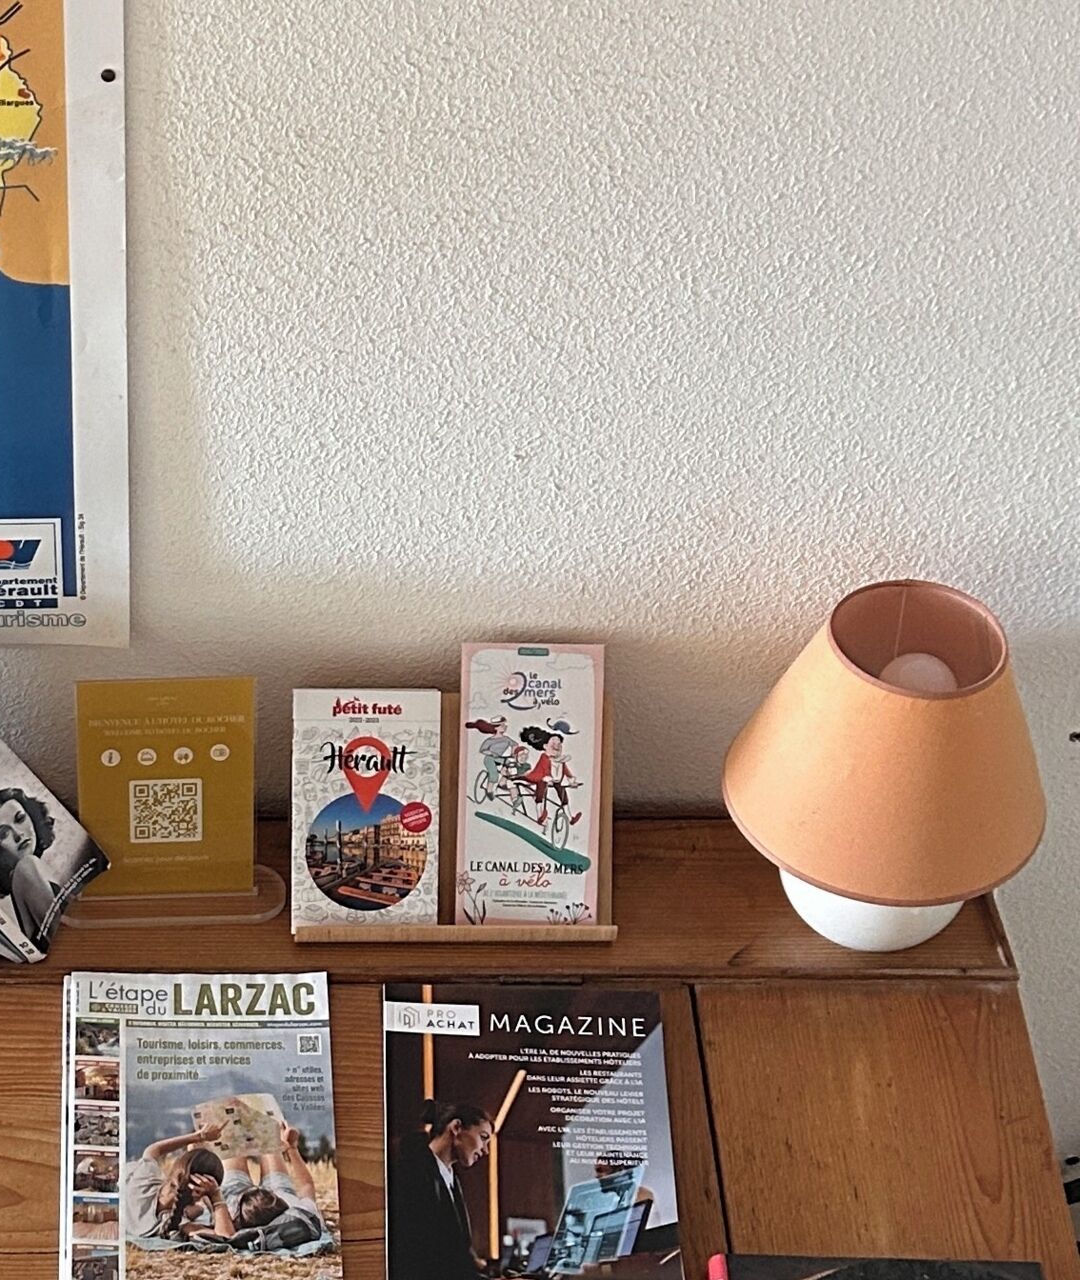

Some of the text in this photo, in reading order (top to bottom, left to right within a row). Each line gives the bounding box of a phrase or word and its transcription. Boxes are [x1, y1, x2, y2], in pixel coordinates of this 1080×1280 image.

[529, 672, 538, 680] le
[527, 679, 562, 690] canal
[503, 687, 519, 696] des
[524, 688, 556, 698] mers
[332, 699, 403, 717] petit futé
[540, 697, 561, 706] vélo
[319, 741, 418, 775] Hérault
[470, 860, 584, 875] LE CANAL DES 2 MERS
[499, 867, 552, 888] à vélo
[88, 980, 169, 1007] L'étape
[172, 982, 316, 1017] LARZAC
[145, 1001, 167, 1017] du
[427, 1009, 457, 1019] PRO
[426, 1018, 476, 1031] ACHAT
[489, 1012, 648, 1038] MAGAZINE
[136, 1054, 252, 1067] entreprises et services
[136, 1068, 149, 1080] de
